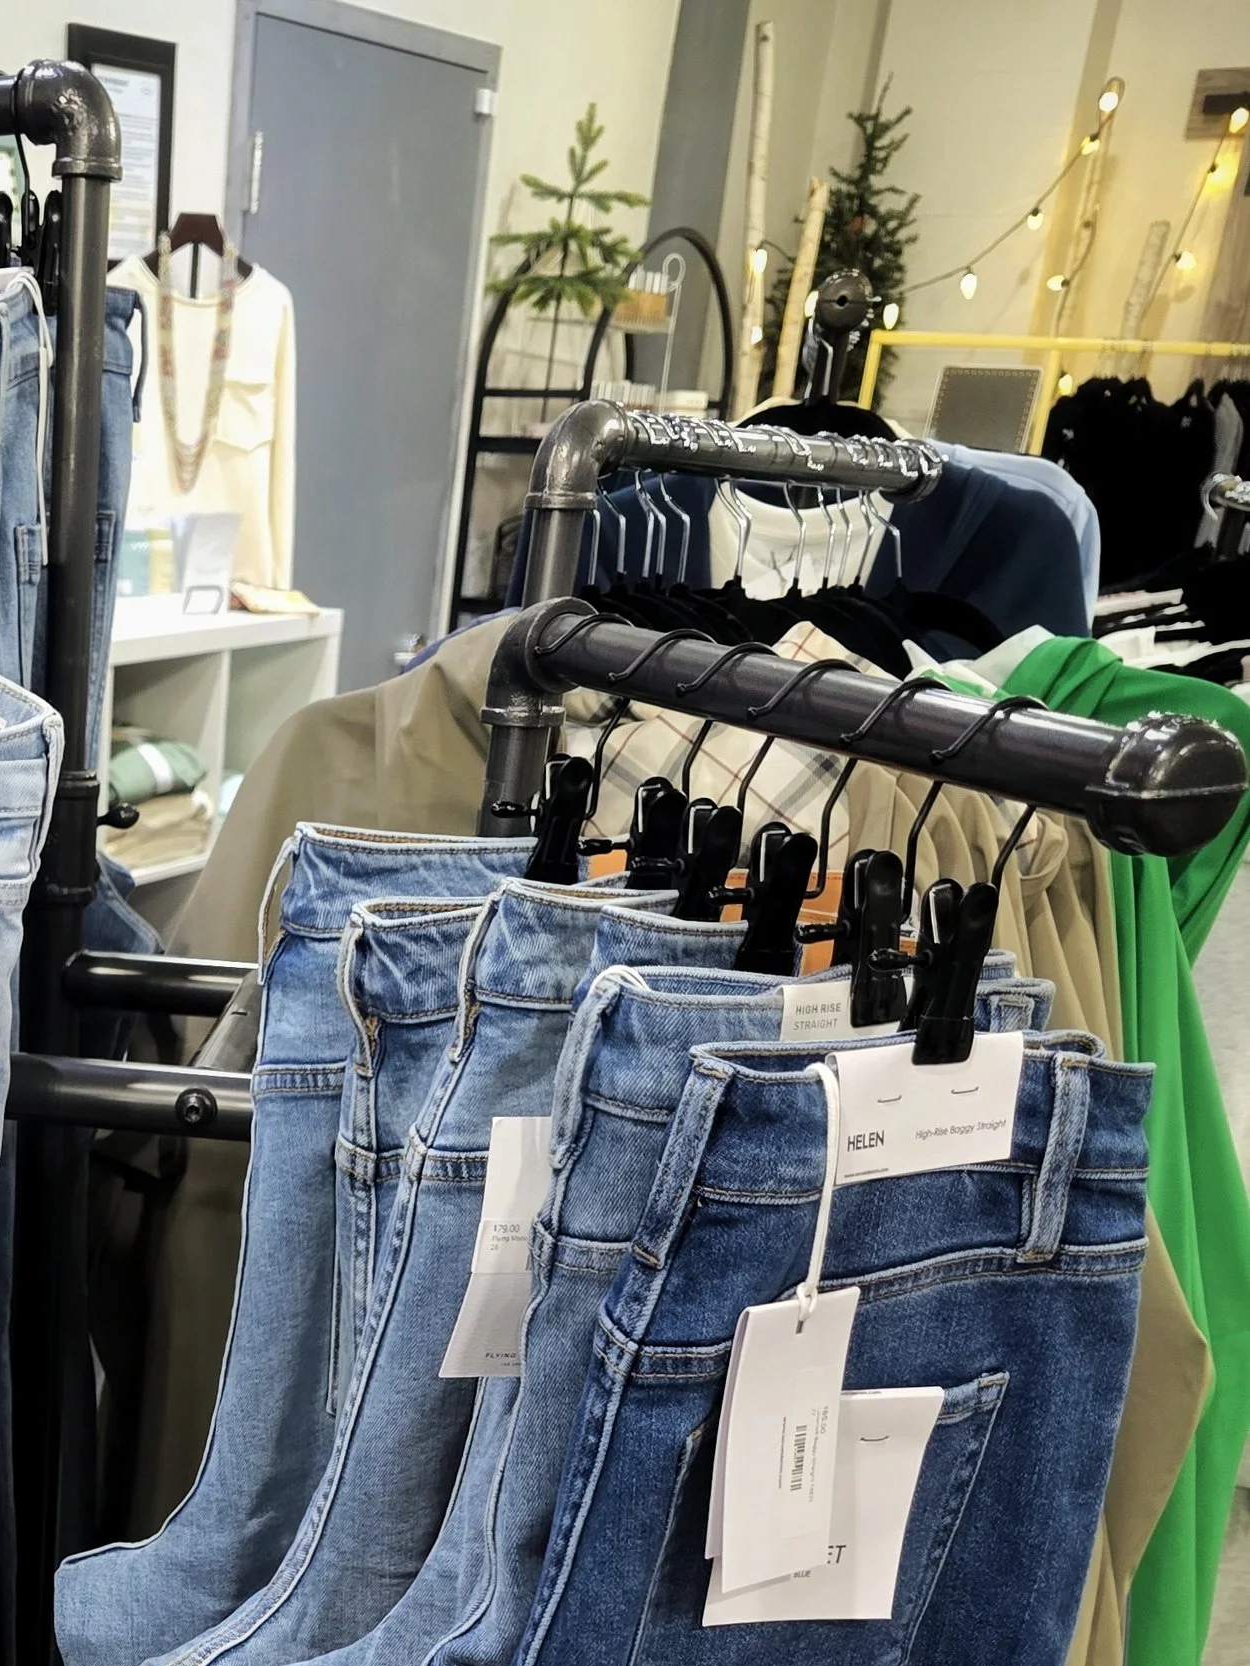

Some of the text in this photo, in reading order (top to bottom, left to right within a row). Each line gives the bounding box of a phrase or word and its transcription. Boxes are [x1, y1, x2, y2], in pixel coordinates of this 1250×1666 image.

[795, 1002, 842, 1016] HIGH RISE
[793, 1018, 839, 1031] STRAIGHT
[915, 1119, 1007, 1141] High-Rise Baggy Straight
[846, 1130, 885, 1152] HELEN
